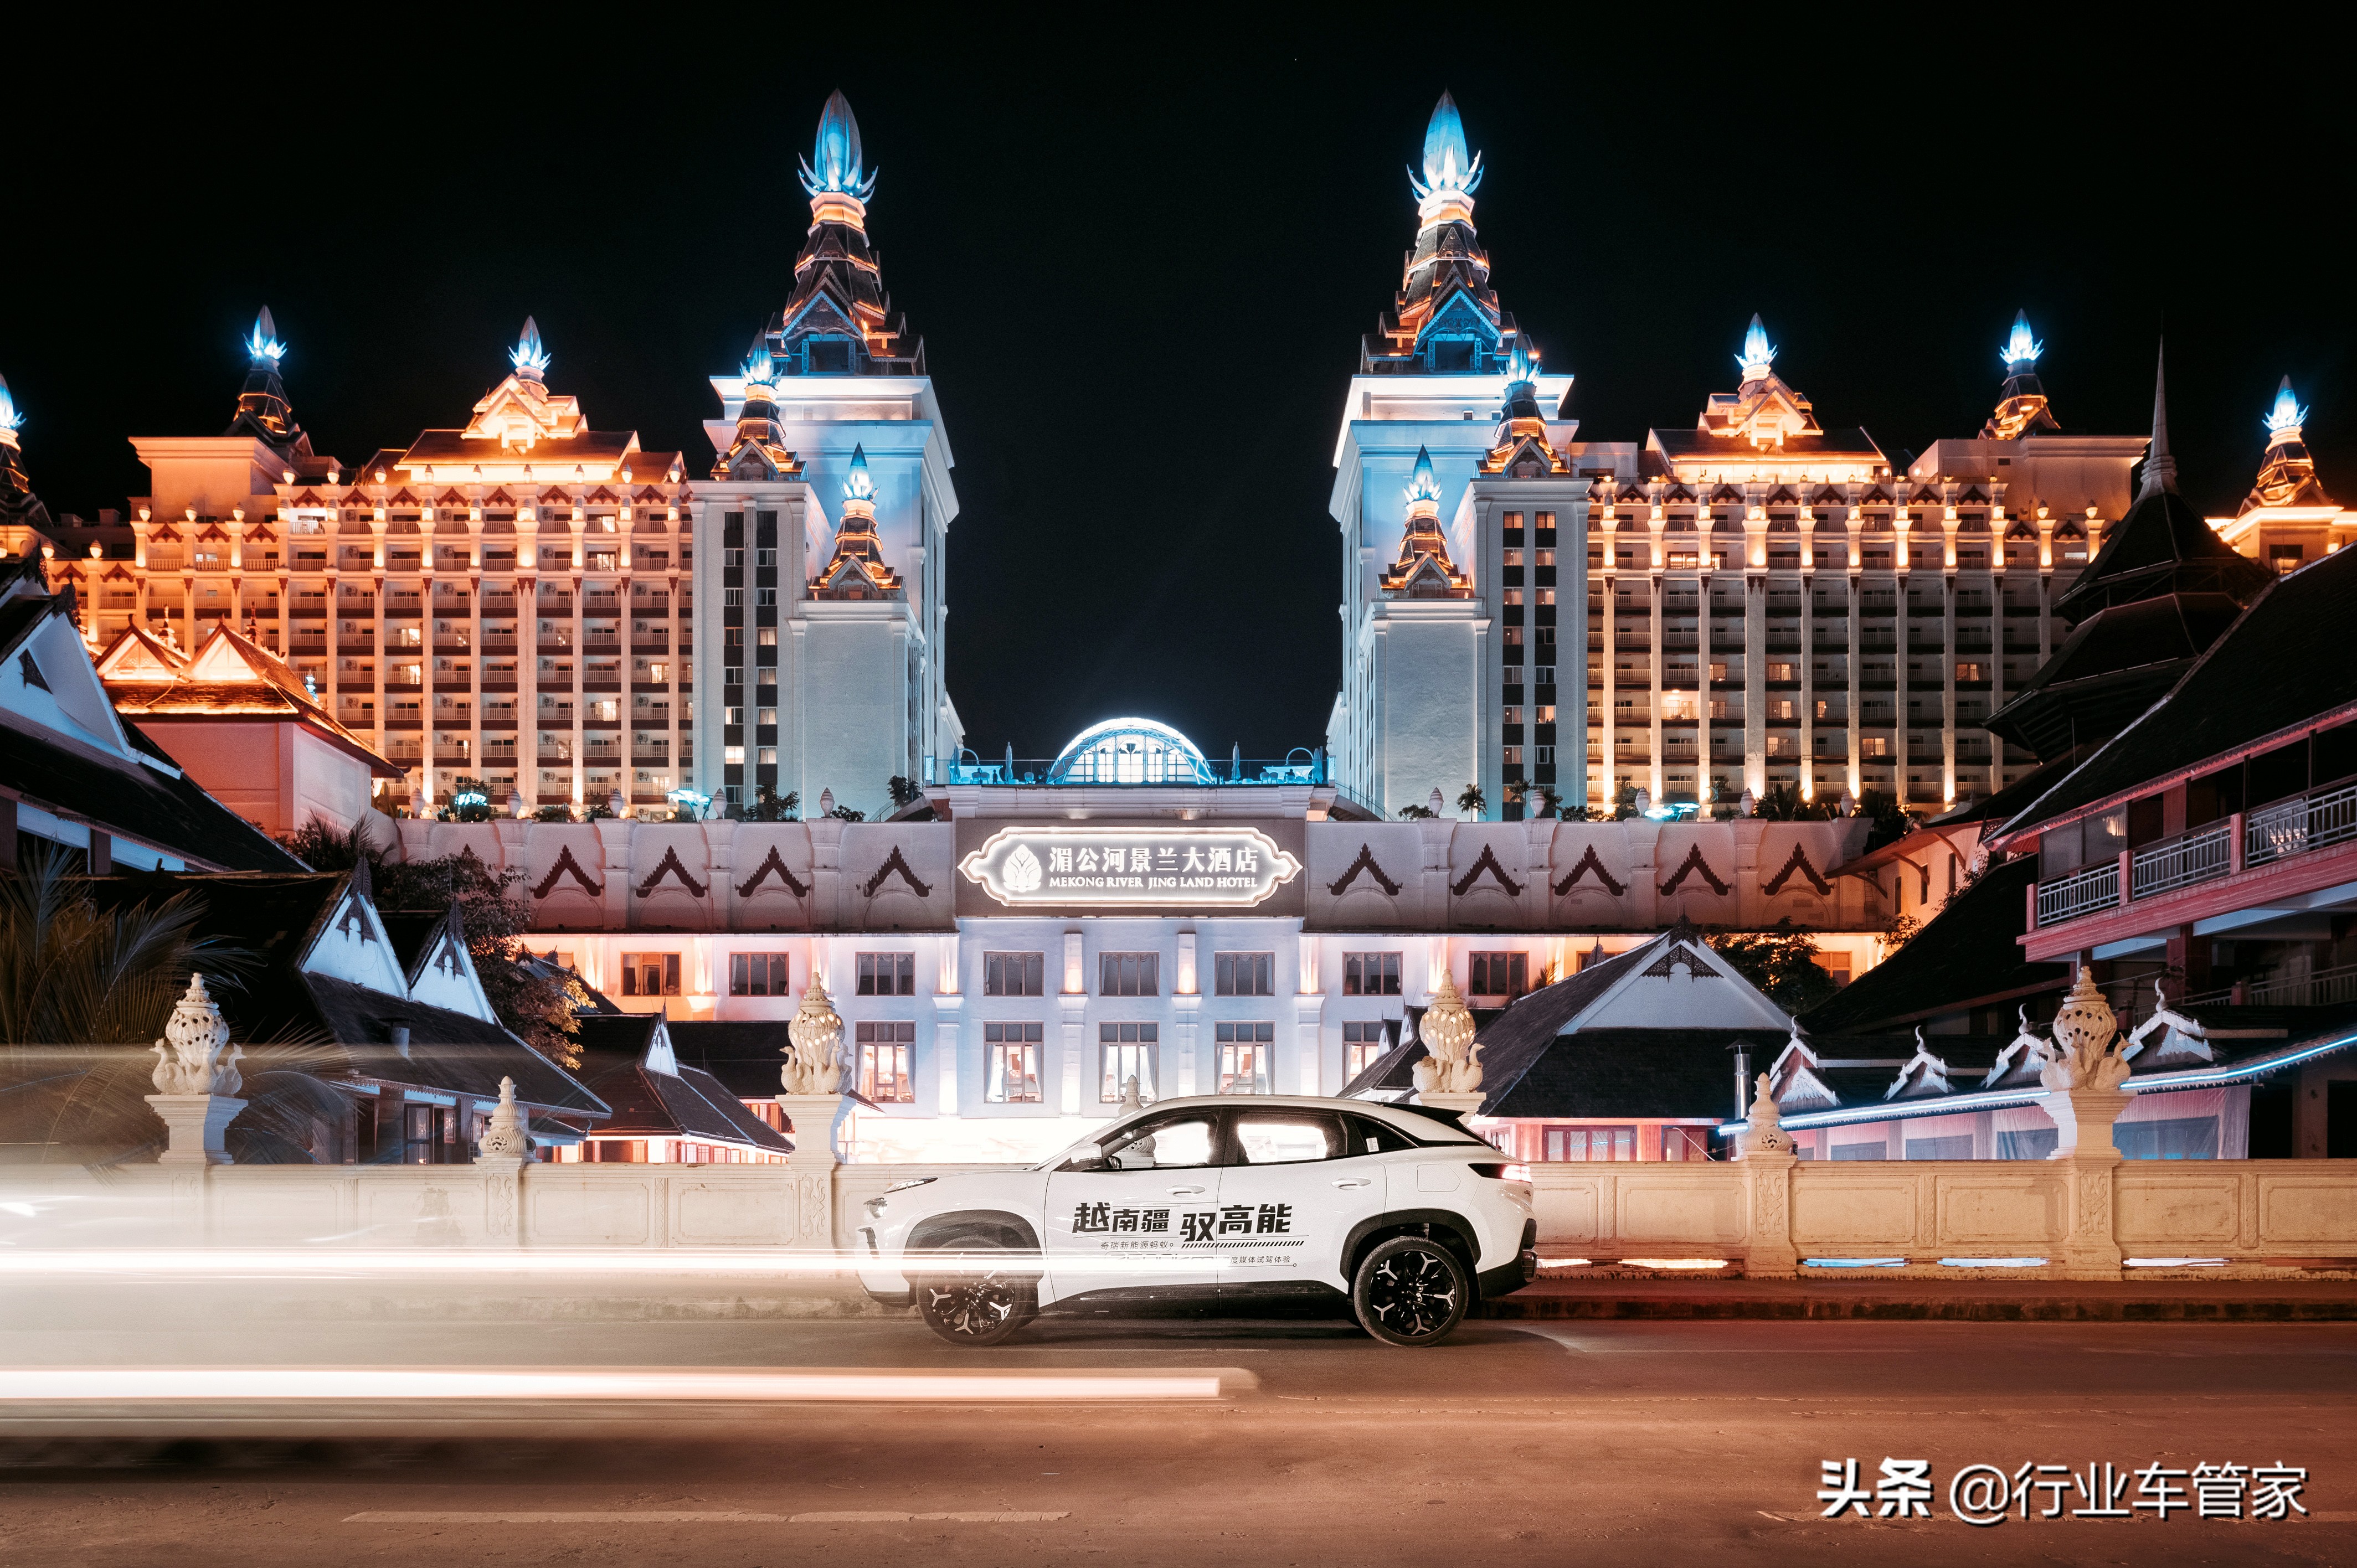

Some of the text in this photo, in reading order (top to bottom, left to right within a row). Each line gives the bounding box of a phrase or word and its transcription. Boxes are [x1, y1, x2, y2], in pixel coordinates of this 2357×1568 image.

[1048, 847, 1258, 873] 湄公河景兰大酒店
[1049, 876, 1258, 890] MEKONG RIVER JING LAND HOTEL
[1072, 1202, 1293, 1242] 越南疆 驭高能
[1100, 1240, 1169, 1250] 奇瑞新能源蚂蚁
[1225, 1255, 1291, 1264] 度媒体试驾体验
